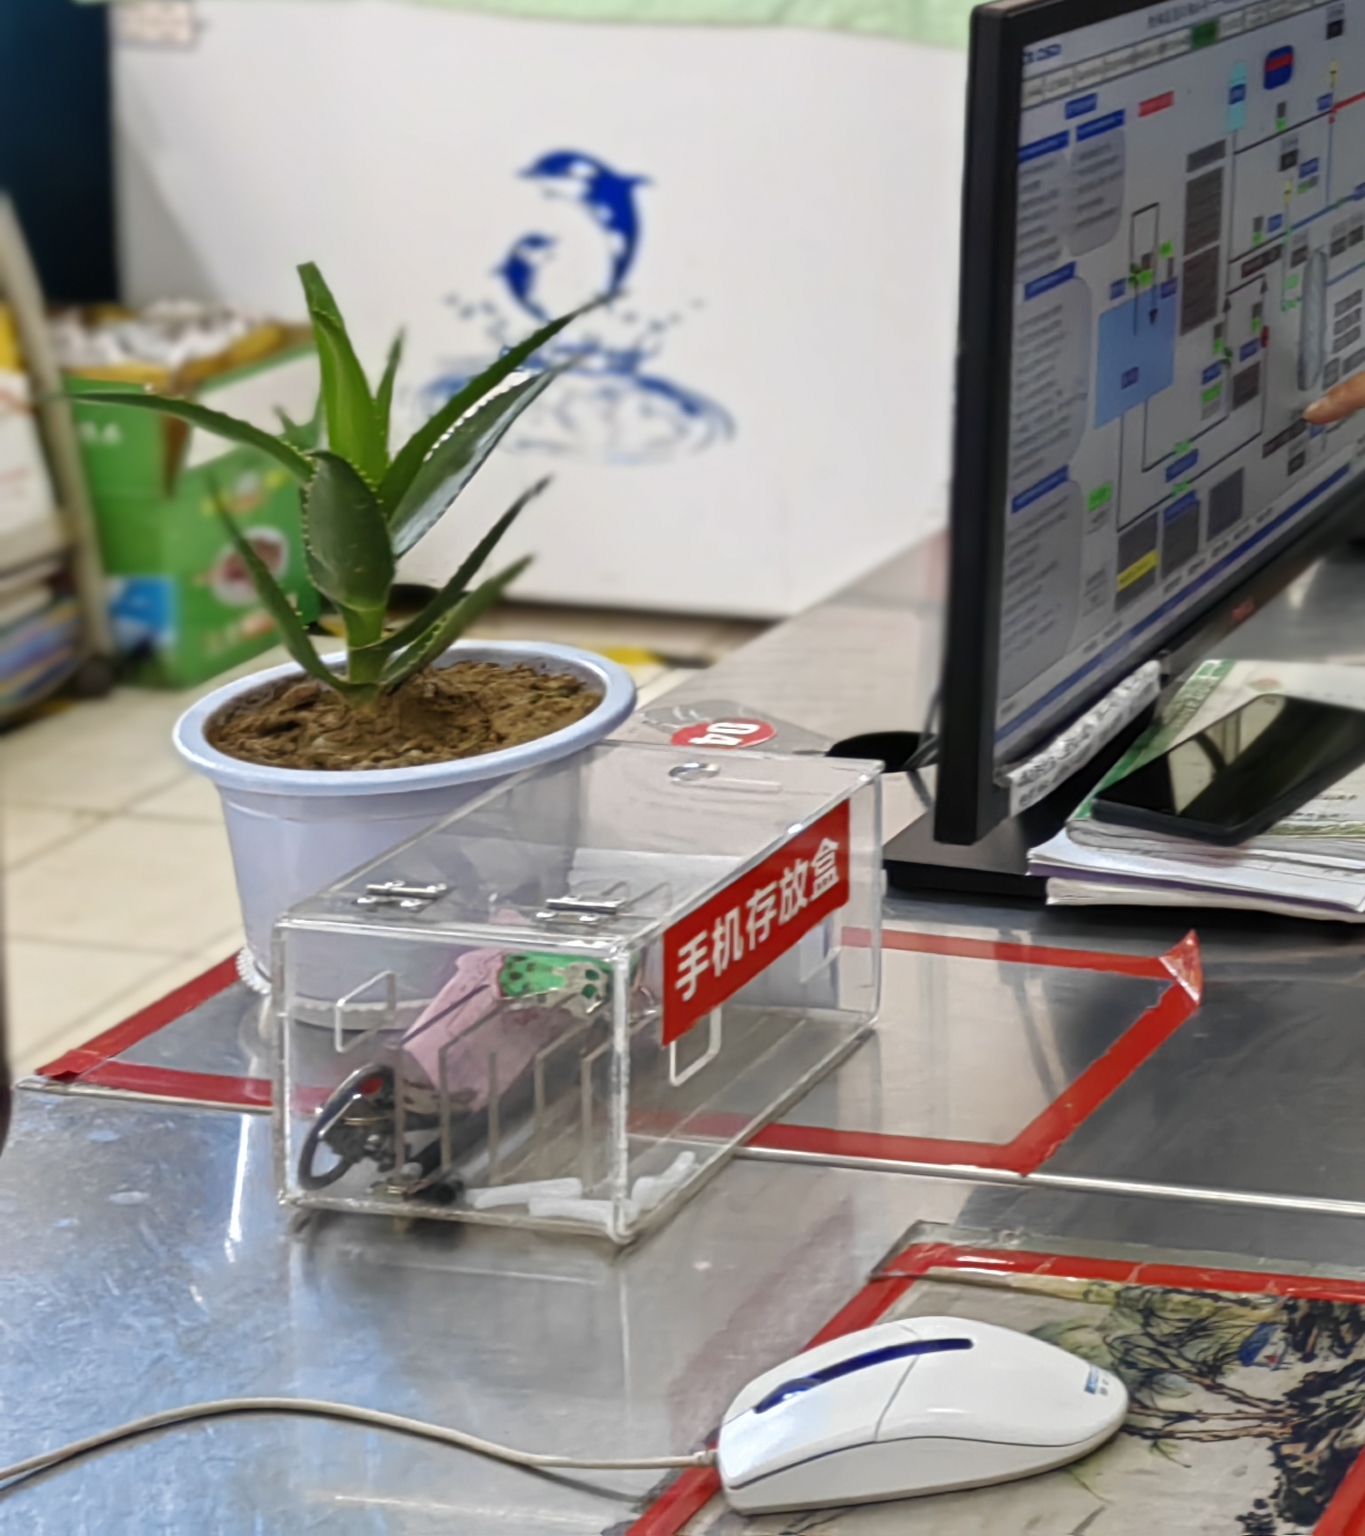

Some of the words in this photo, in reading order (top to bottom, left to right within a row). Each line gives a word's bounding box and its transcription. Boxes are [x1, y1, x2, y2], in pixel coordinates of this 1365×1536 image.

[688, 721, 761, 746] 04
[674, 836, 841, 1003] 手机存放盒
